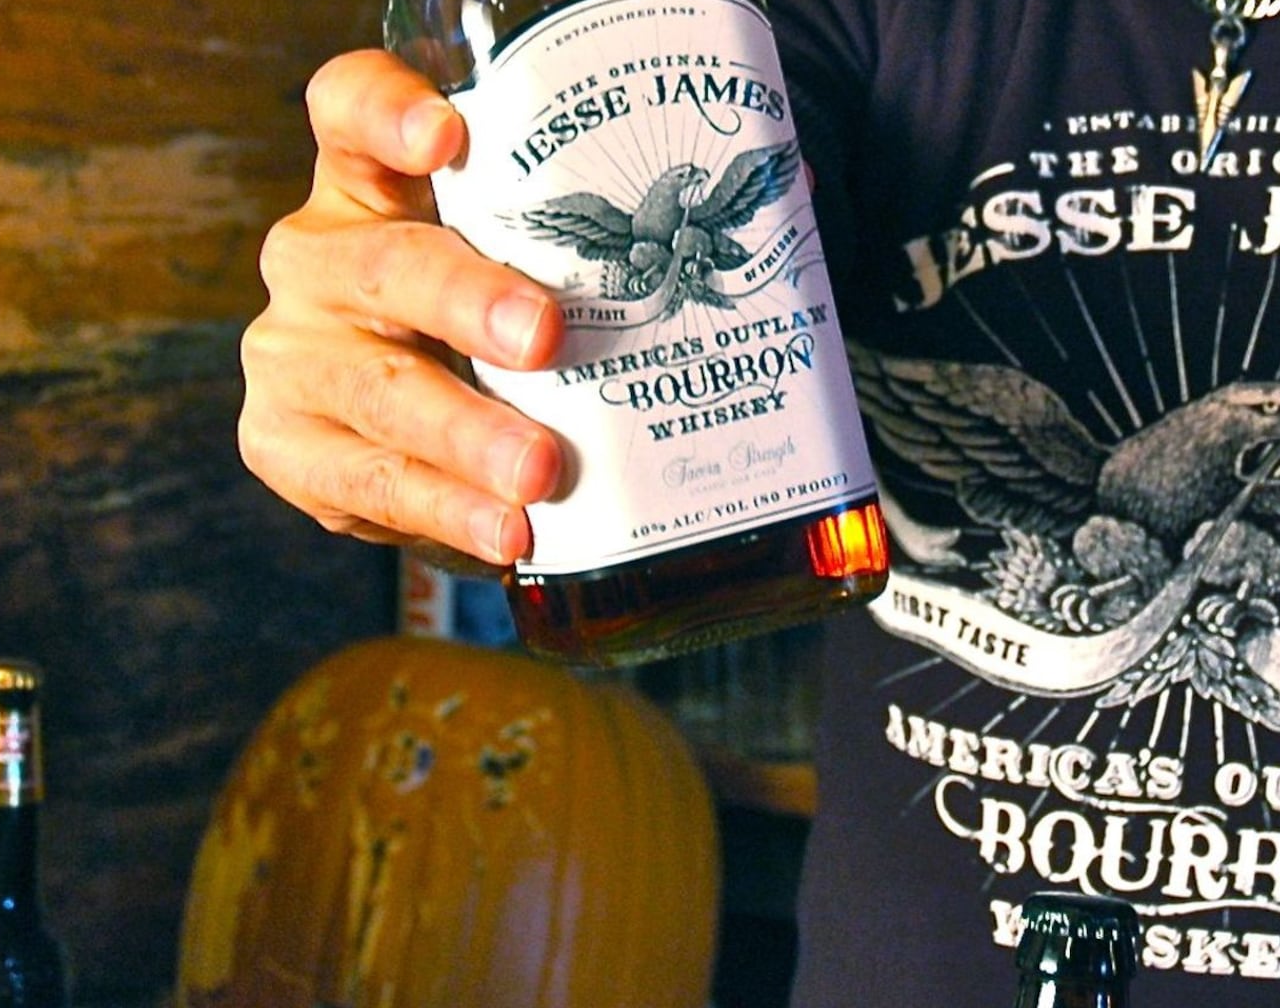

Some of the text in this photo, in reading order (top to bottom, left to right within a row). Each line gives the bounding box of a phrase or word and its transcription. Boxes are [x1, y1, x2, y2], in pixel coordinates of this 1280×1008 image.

[555, 8, 656, 46] ESTABLISHED
[556, 54, 721, 103] THE ORIGINAL
[510, 73, 785, 182] JESSE JAMES
[1030, 145, 1139, 178] THE
[893, 184, 1196, 313] JESSE
[556, 303, 827, 387] AMERICA'S OUTLAW
[602, 333, 815, 411] BOURBON
[647, 390, 788, 442] WHISKEY
[630, 520, 667, 540] 40%
[673, 500, 749, 529] ALC/VOL
[787, 472, 849, 499] PROOF)
[892, 589, 950, 629] FIRST
[956, 617, 1032, 668] TASTE
[885, 702, 1185, 800] AMERICA'S
